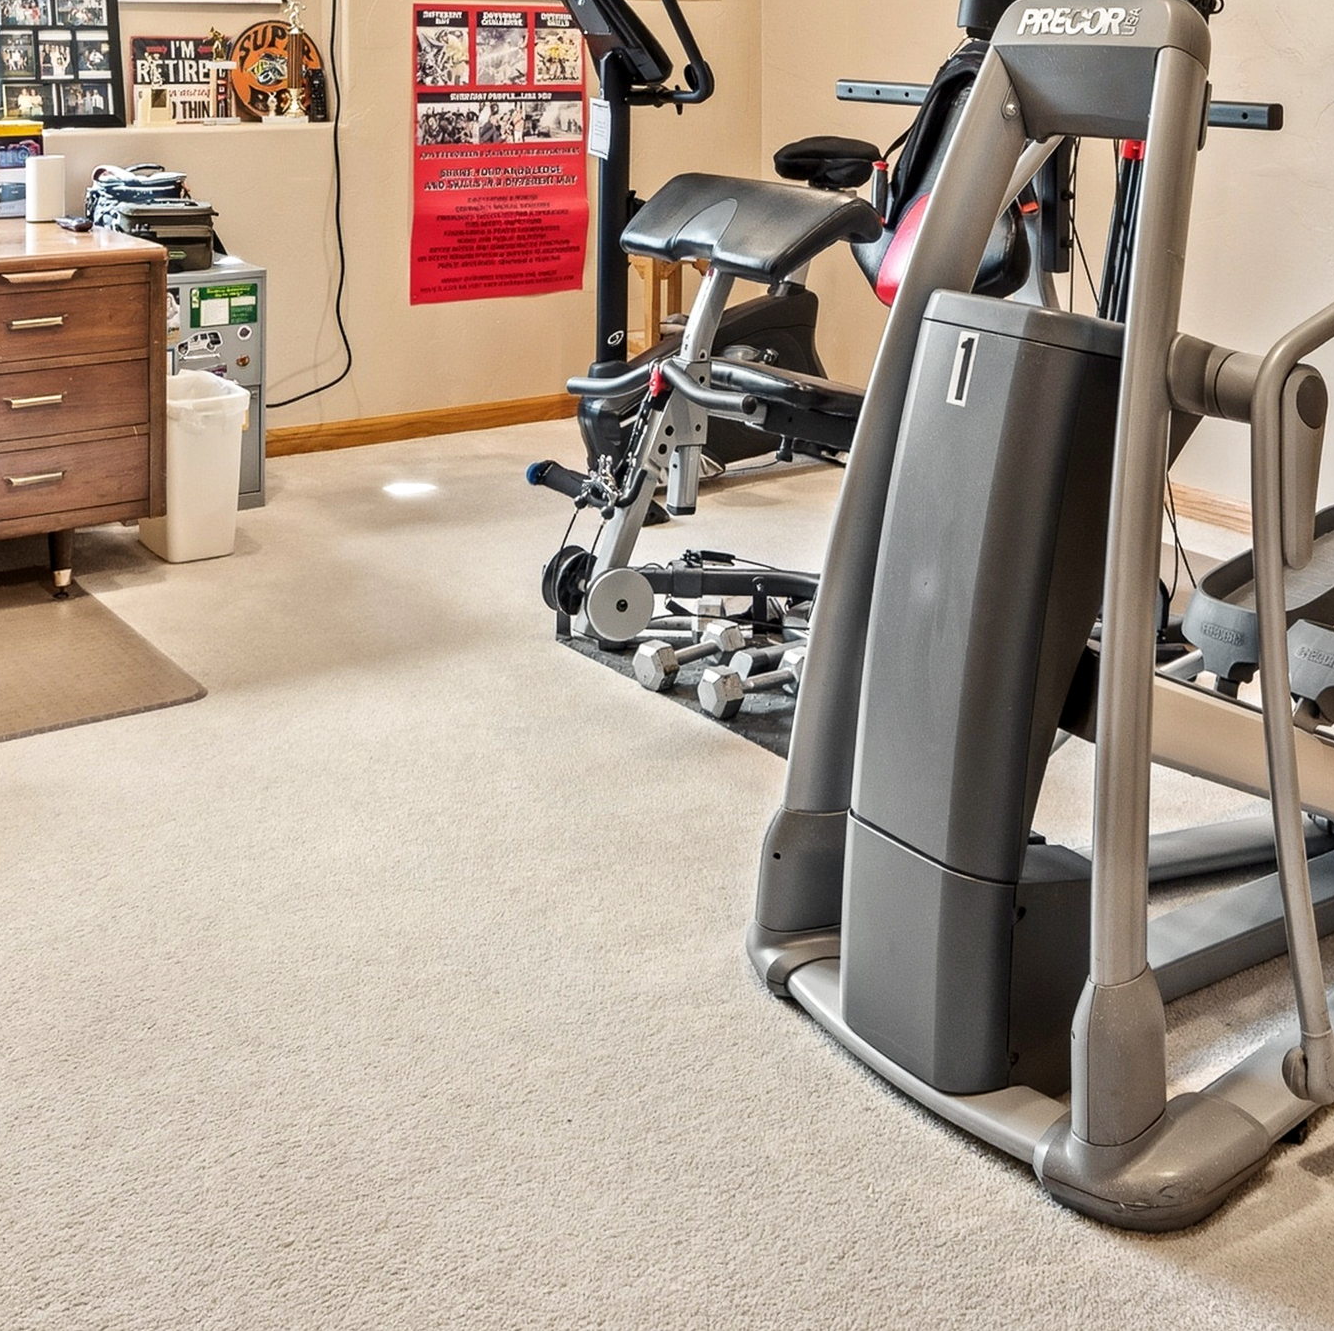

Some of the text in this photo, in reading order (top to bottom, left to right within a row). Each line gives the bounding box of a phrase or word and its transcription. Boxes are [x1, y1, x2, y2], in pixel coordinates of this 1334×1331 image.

[1016, 7, 1126, 36] PRECOR
[170, 40, 195, 59] I'M
[238, 24, 315, 73] SUPR
[136, 59, 211, 83] RETIRE
[180, 100, 210, 119] THIN
[424, 180, 445, 191] AND
[954, 337, 975, 401] 1
